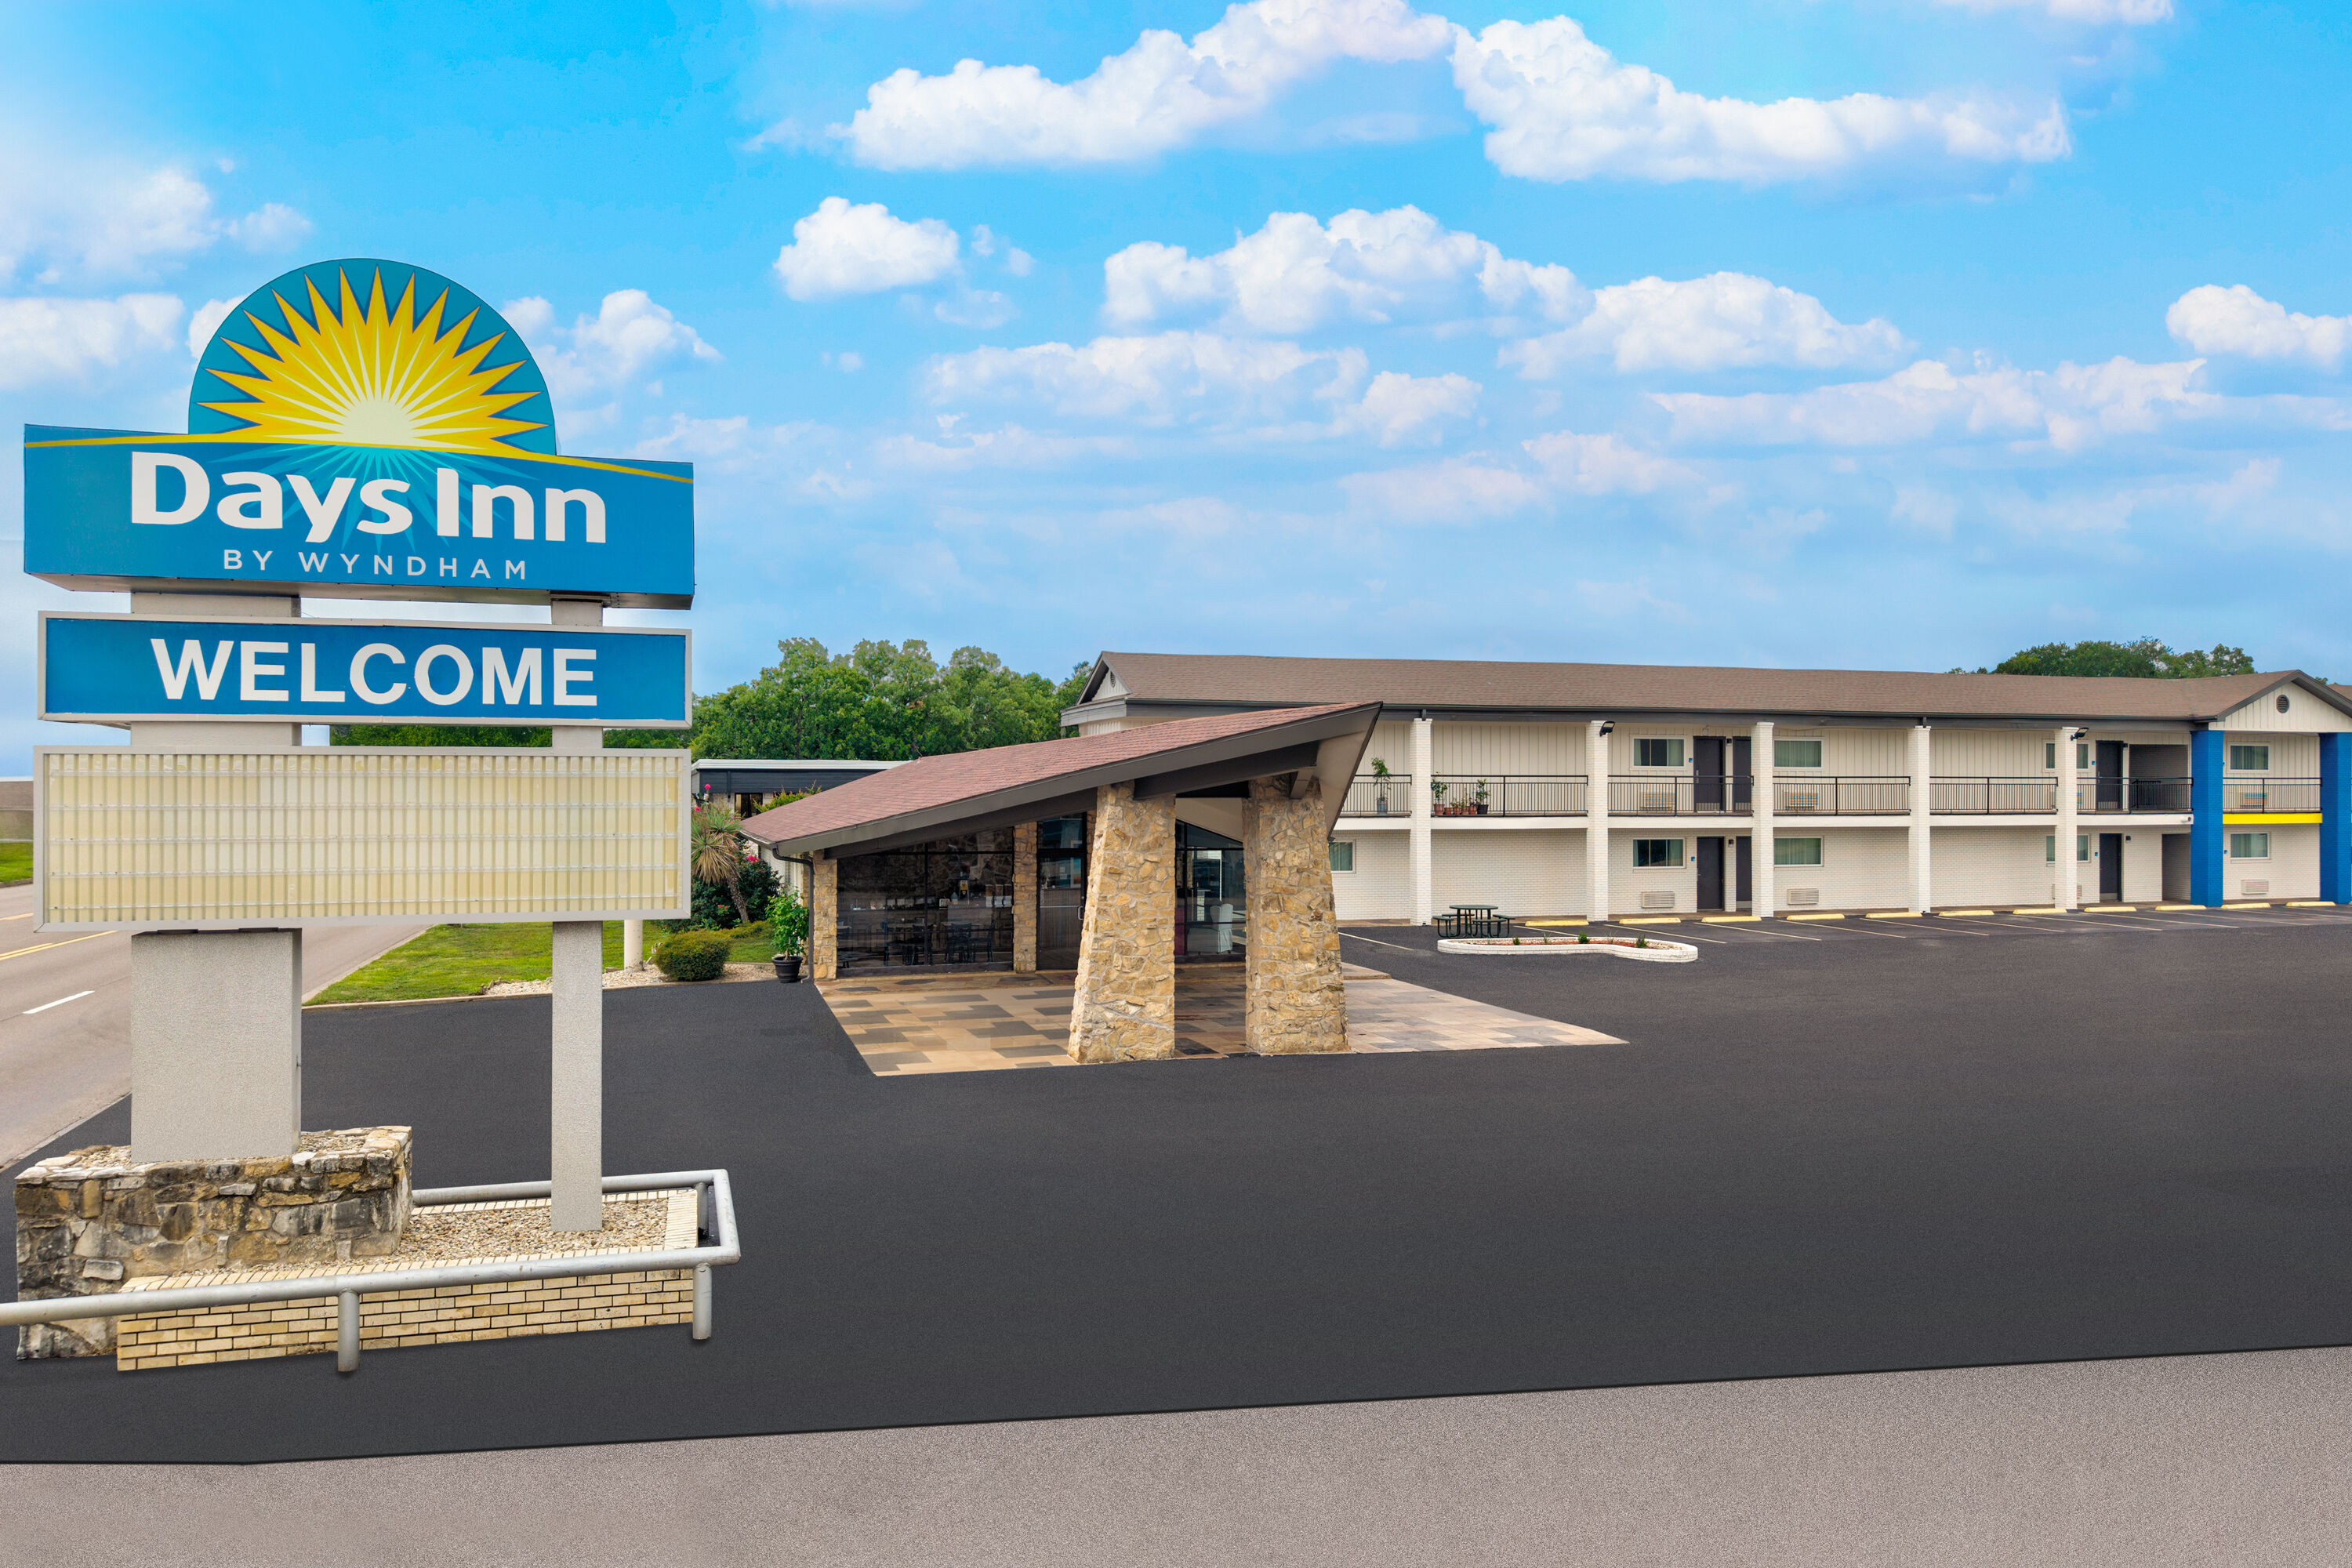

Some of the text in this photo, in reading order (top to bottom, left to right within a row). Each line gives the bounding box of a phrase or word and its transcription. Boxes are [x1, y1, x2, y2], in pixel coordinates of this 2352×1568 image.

[131, 451, 607, 544] Days Inn
[224, 549, 527, 580] BY WYNDHAM
[150, 638, 598, 707] WELCOME
